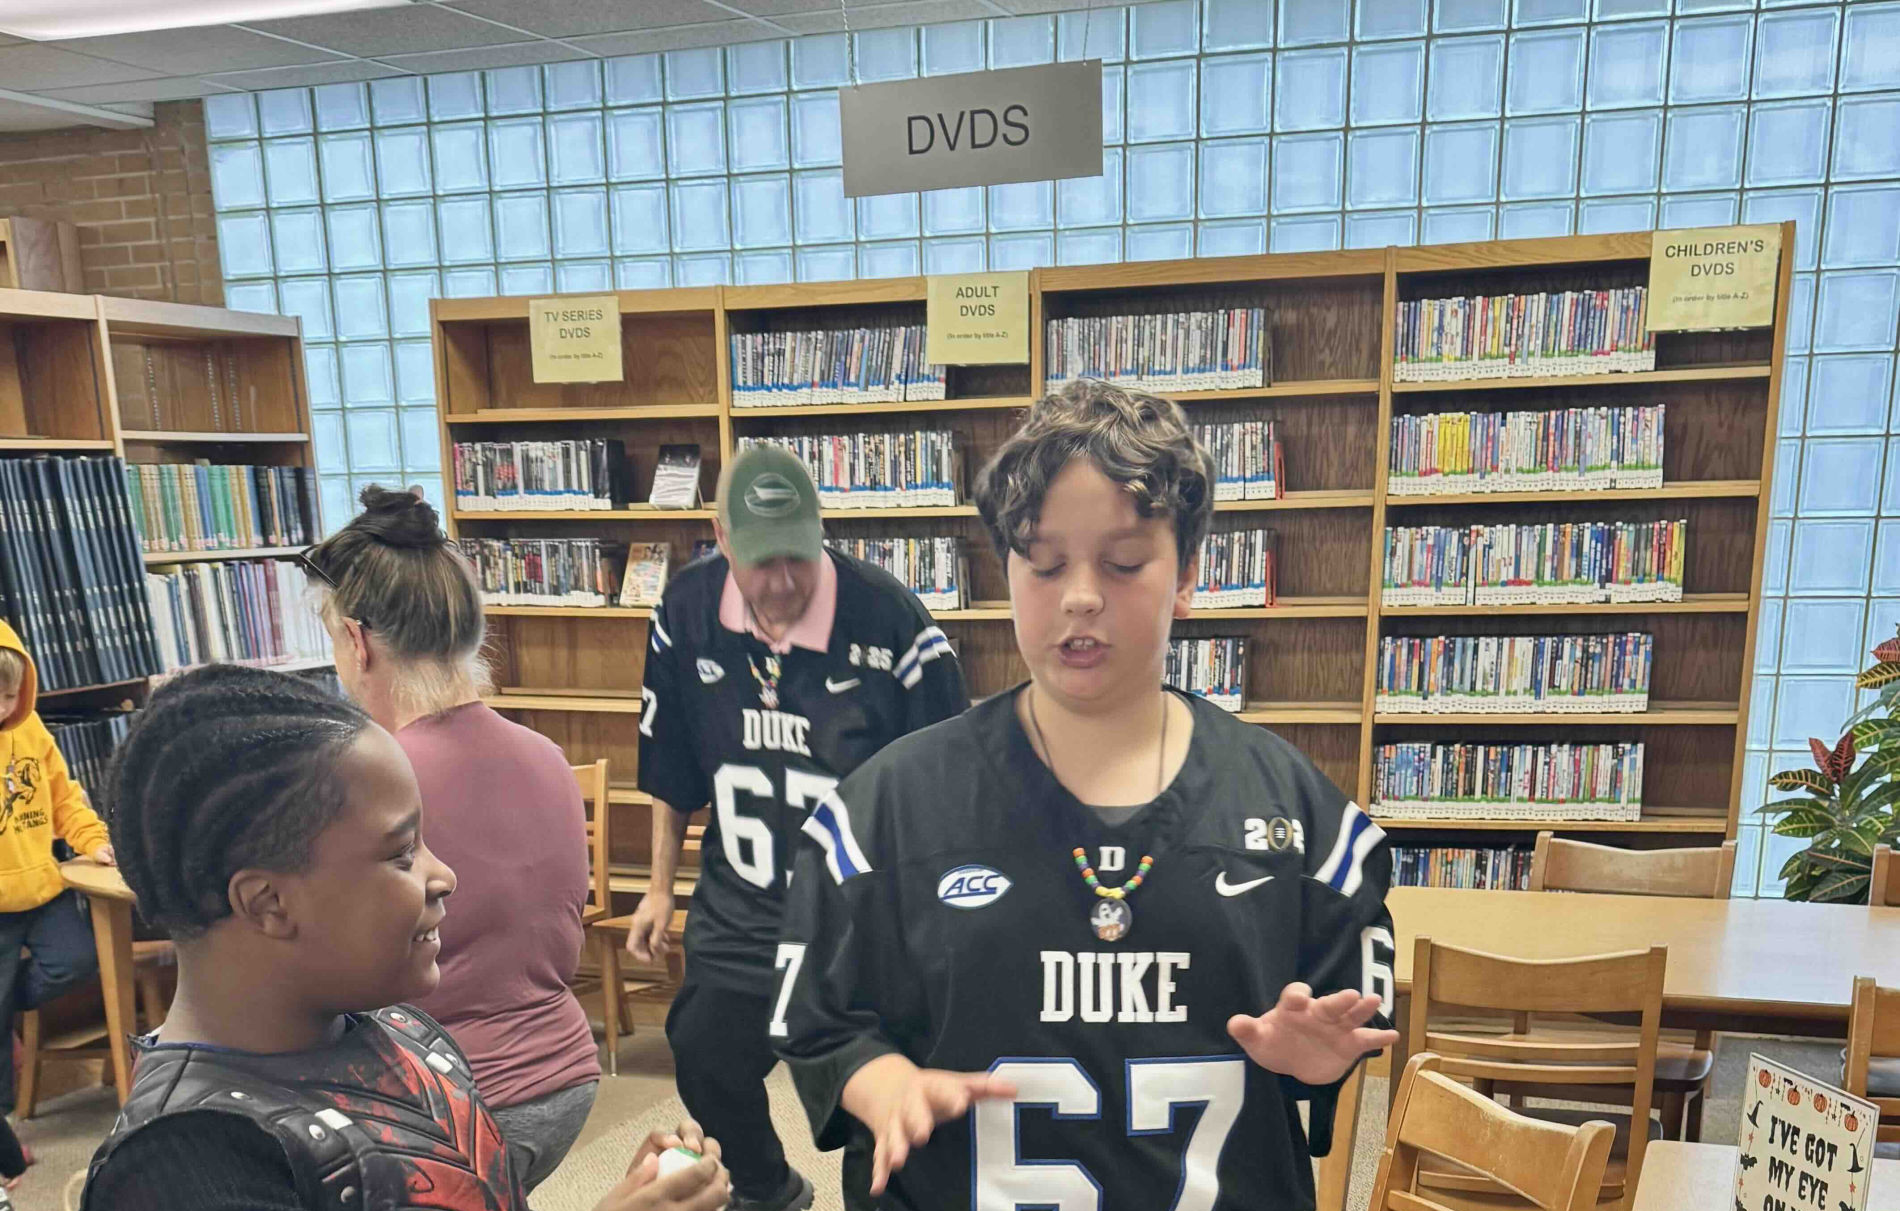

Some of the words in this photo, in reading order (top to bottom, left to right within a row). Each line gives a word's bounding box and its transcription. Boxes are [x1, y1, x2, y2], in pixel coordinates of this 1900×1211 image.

[907, 104, 1031, 156] DVDS
[1664, 239, 1764, 258] CHILDREN'S
[1690, 262, 1735, 277] DVDS
[955, 286, 1000, 298] ADULT
[544, 311, 559, 322] TV
[561, 309, 604, 322] SERIES
[960, 304, 996, 317] DVDS
[559, 326, 591, 339] DVDS
[741, 708, 812, 758] DUKE
[1098, 846, 1126, 871] D
[943, 874, 1004, 897] ACC
[1360, 925, 1395, 1020] 6
[769, 942, 808, 1036] 7
[1039, 950, 1192, 1023] DUKE
[1768, 1115, 1801, 1156] I'VE
[1804, 1133, 1838, 1172] GOT
[1768, 1156, 1796, 1192] MY
[1797, 1170, 1829, 1211] EYE
